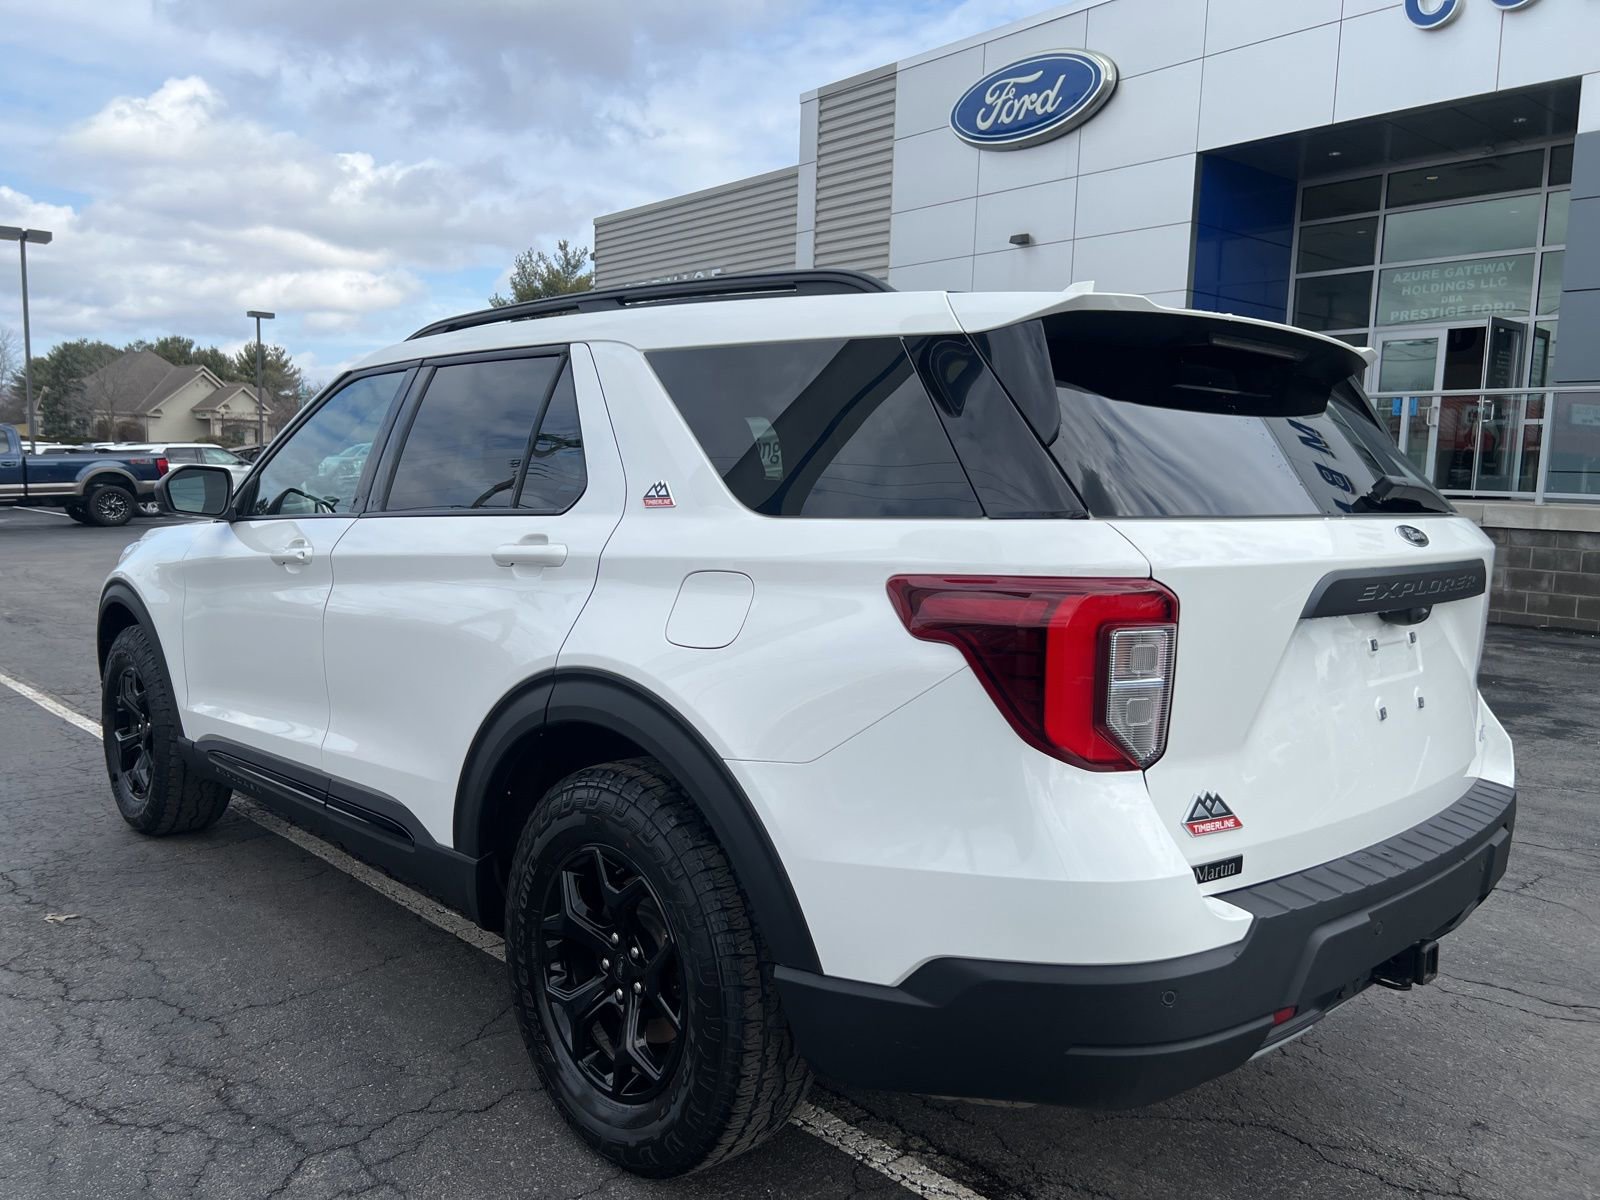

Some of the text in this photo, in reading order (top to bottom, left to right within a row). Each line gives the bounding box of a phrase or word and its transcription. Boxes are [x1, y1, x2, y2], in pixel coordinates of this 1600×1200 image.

[976, 70, 1066, 130] Ford
[1393, 260, 1516, 283] AZURE GATEWAY
[1402, 277, 1508, 295] HOLDINGS LLC
[1441, 295, 1463, 303] DBA
[1390, 302, 1516, 321] PRESTIGE FORD
[1357, 575, 1477, 602] EXPLORER
[1193, 819, 1235, 833] TIMBERLINE
[1195, 861, 1236, 881] Martin
